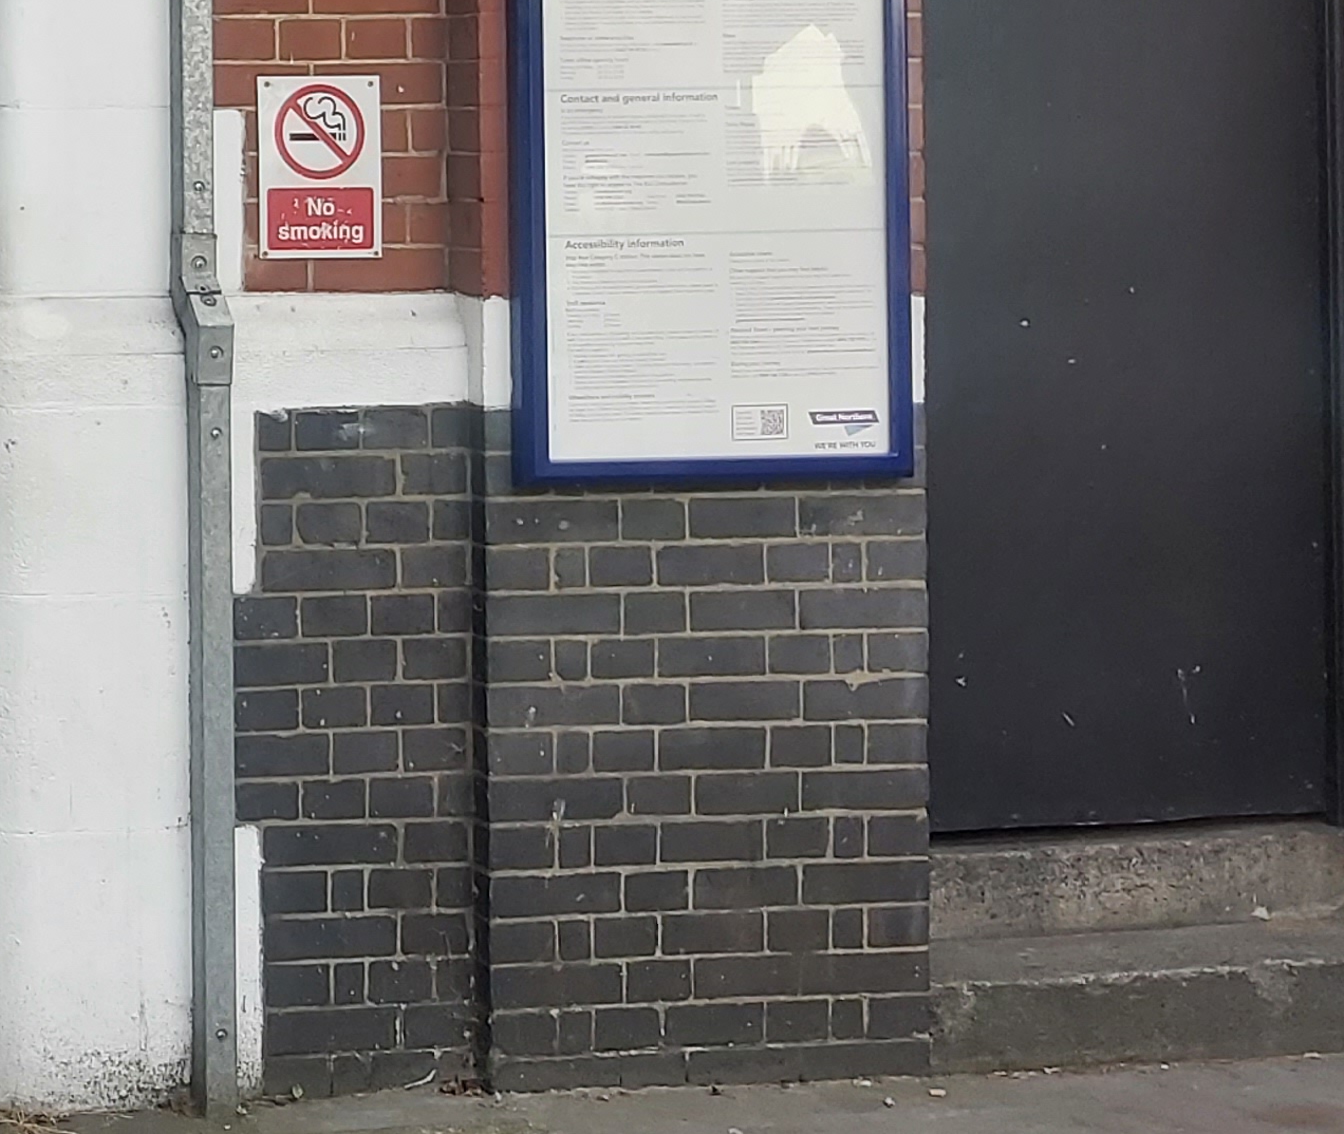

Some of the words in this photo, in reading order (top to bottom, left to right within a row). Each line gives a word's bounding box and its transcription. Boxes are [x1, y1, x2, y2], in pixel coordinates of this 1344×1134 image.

[560, 94, 599, 103] Contact
[602, 94, 619, 103] and
[623, 94, 660, 105] general
[663, 93, 719, 102] information
[306, 197, 335, 216] No
[278, 220, 365, 243] smoking
[565, 239, 624, 250] Accessibility
[627, 239, 684, 248] information
[840, 441, 858, 449] WITH
[861, 441, 876, 449] YOU
